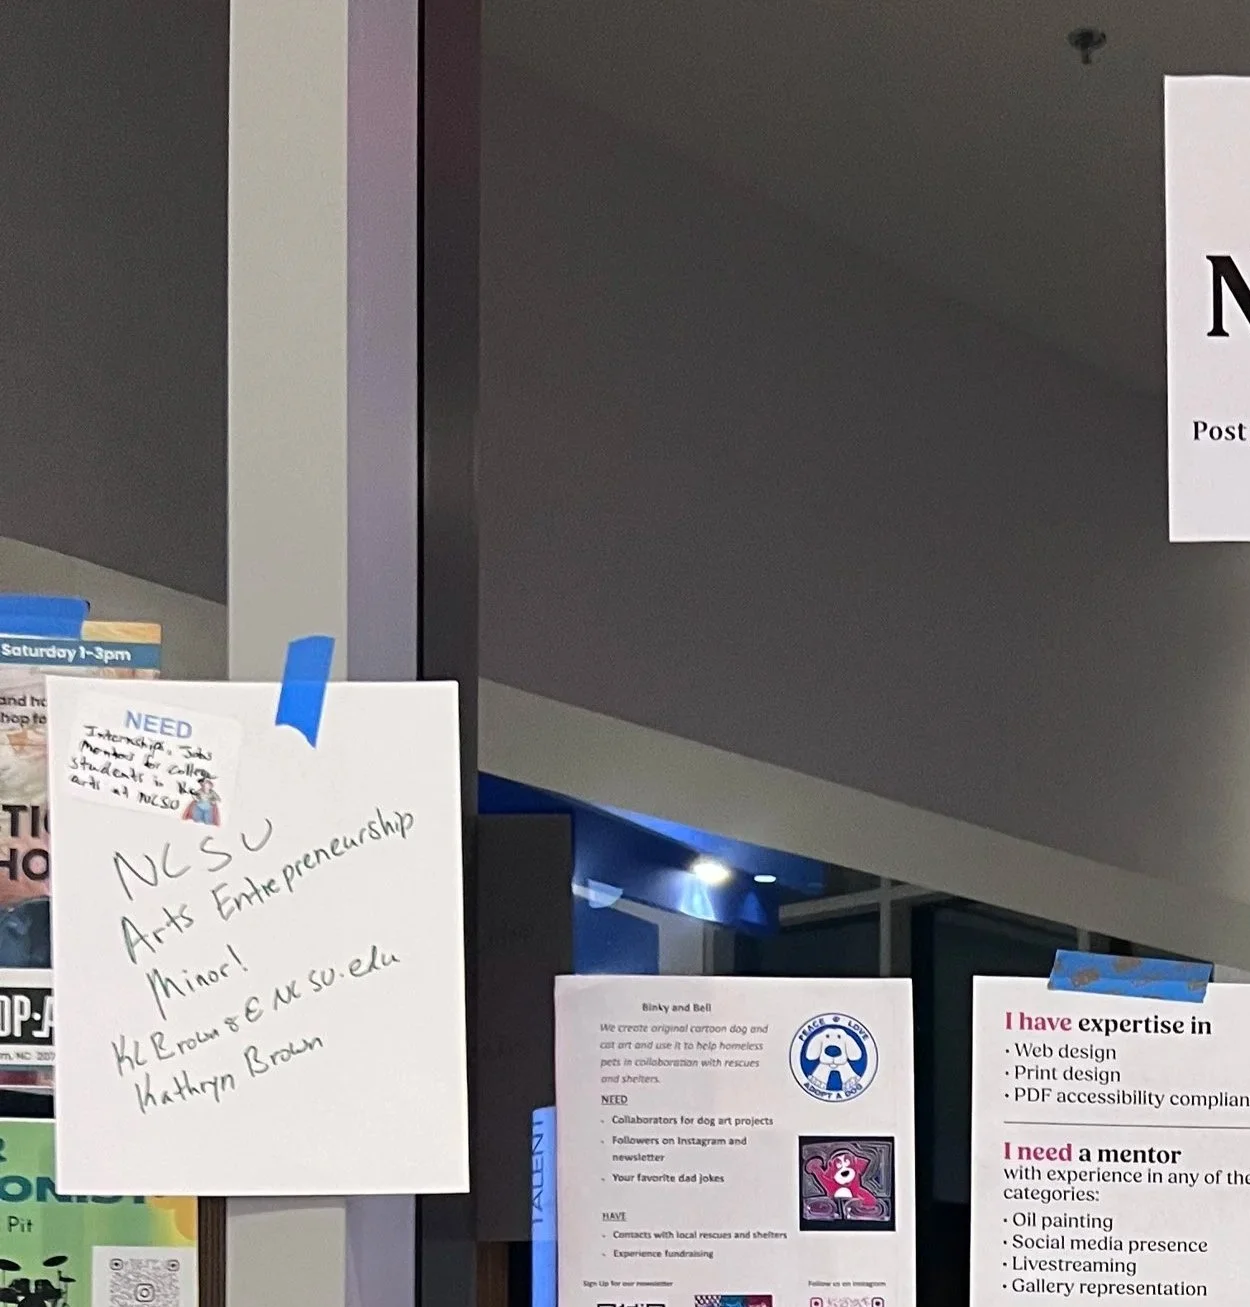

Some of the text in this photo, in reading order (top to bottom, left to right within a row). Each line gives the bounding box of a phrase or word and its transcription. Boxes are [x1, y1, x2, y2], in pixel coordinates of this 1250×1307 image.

[1194, 421, 1246, 440] Post
[0, 644, 132, 662] Saturday 1-3pm
[123, 710, 192, 738] NEED
[121, 808, 414, 964] Arts Entrepreneurship
[146, 945, 249, 1020] Minor!
[642, 1003, 711, 1013] Binky and Bell
[1006, 1012, 1211, 1036] I have expertise in
[1015, 1043, 1116, 1062] Web design
[135, 1037, 323, 1114] Kathryn Brown
[1015, 1065, 1120, 1085] Print design
[1015, 1088, 1051, 1102] PDF
[1057, 1090, 1164, 1108] accessibility
[681, 1116, 694, 1124] for
[697, 1117, 715, 1126] dog
[735, 1117, 773, 1126] projects
[1005, 1142, 1181, 1163] I need a mentor
[637, 1173, 675, 1182] favorite
[679, 1174, 696, 1182] dad
[700, 1174, 724, 1184] jokes
[8, 1216, 32, 1232] Pit
[1013, 1213, 1112, 1232] Oil painting
